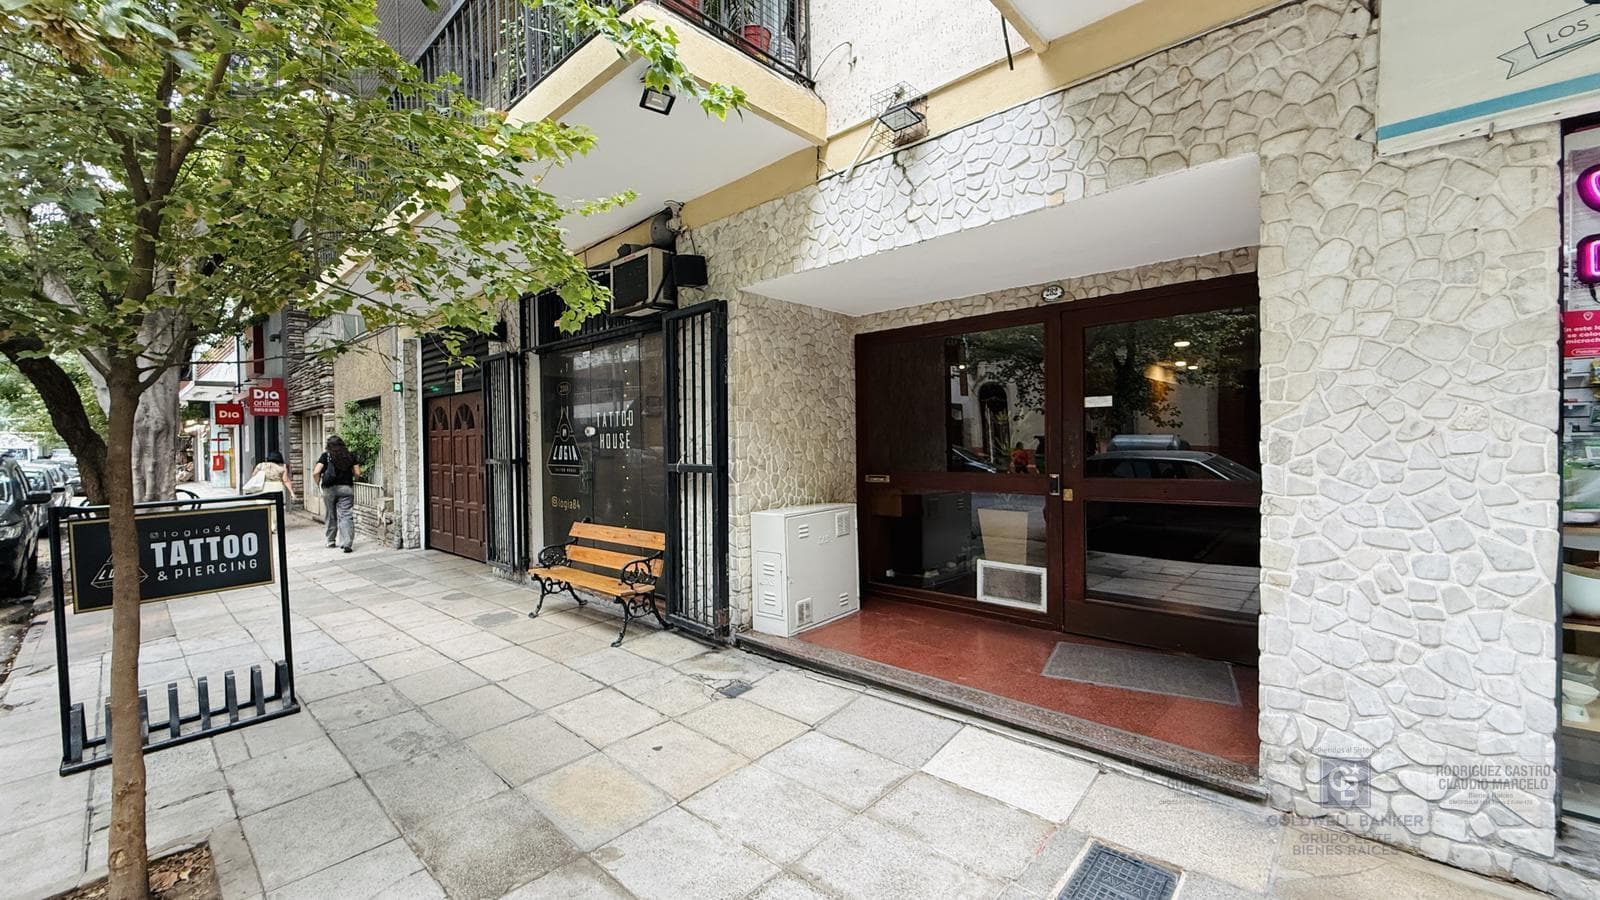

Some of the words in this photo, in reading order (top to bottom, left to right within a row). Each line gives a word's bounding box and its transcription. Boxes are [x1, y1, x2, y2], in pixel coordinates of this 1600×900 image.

[1547, 20, 1589, 43] LOS
[596, 409, 634, 428] TATTOO
[600, 432, 631, 449] HOUSE
[151, 533, 258, 567] TATTOO
[157, 571, 168, 581] &
[175, 558, 257, 579] PIERCING
